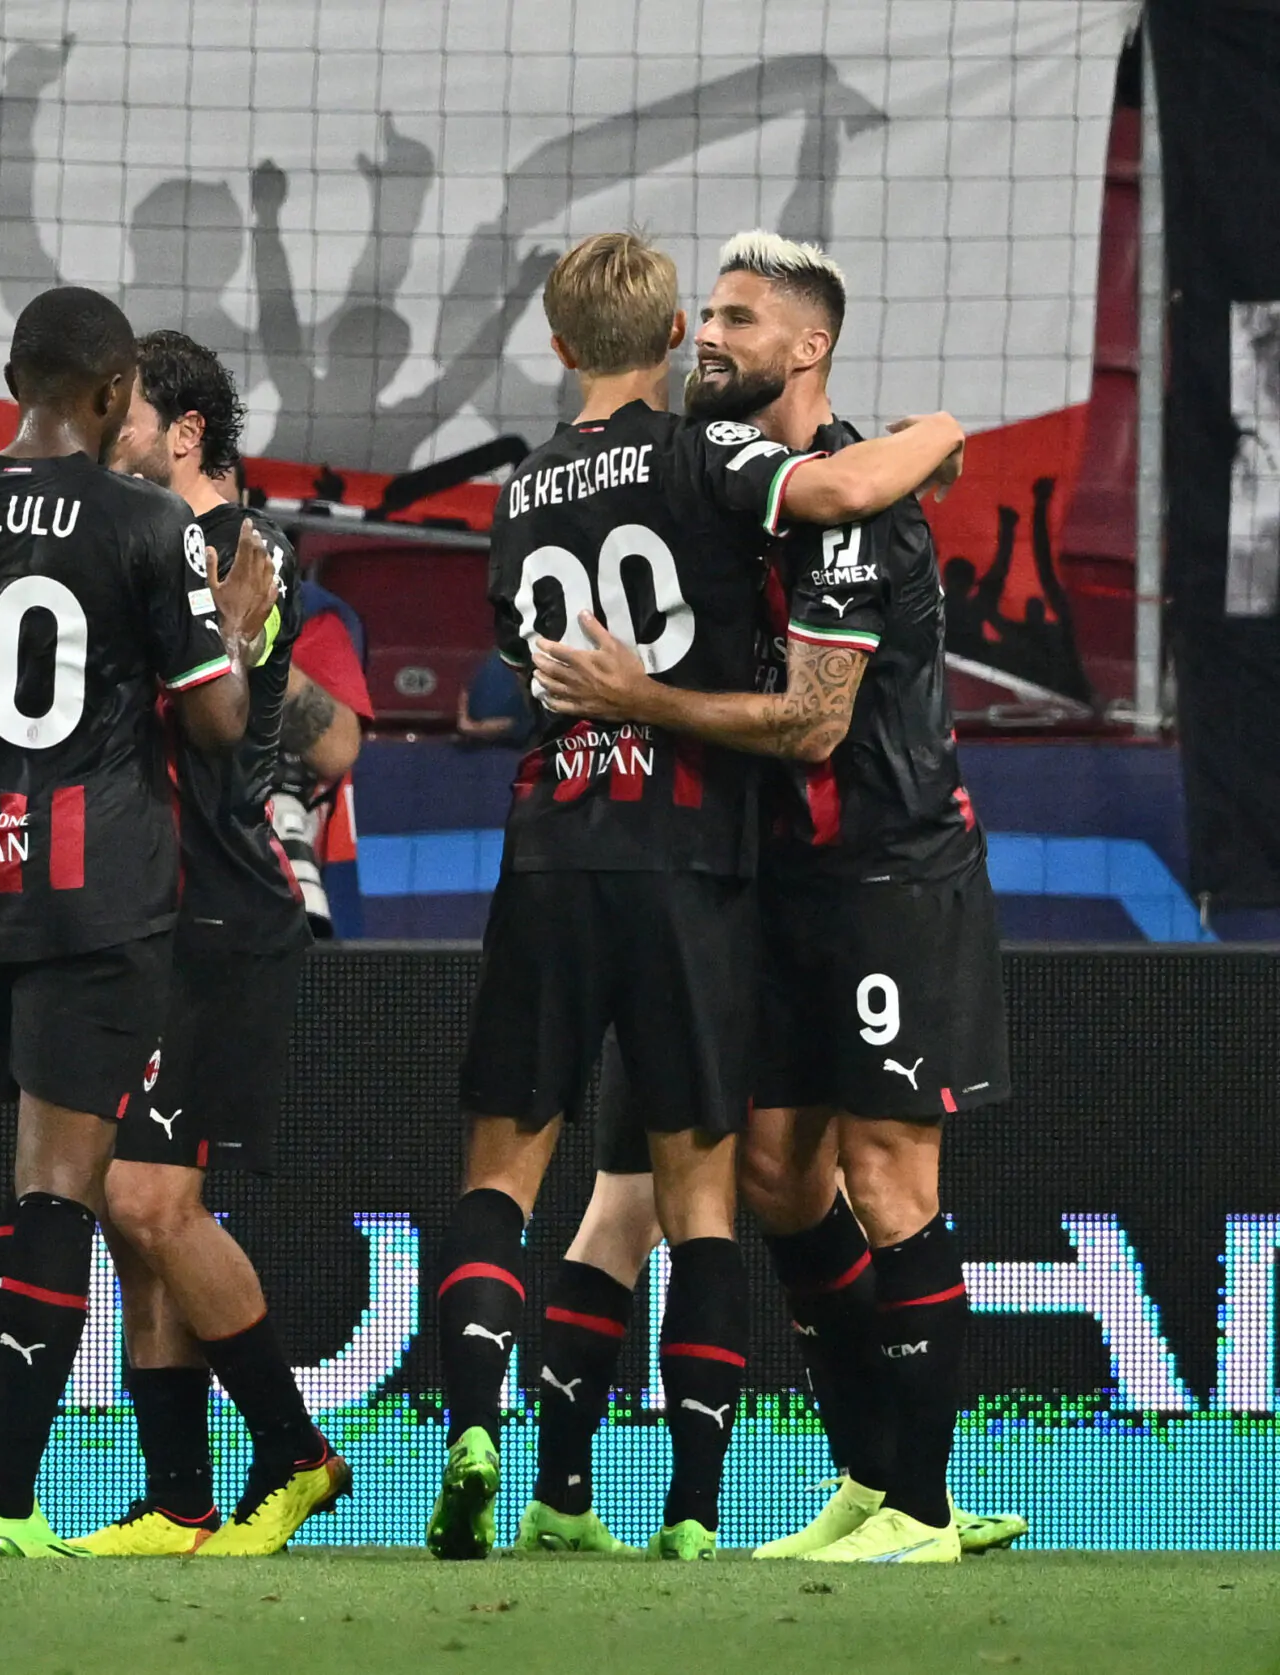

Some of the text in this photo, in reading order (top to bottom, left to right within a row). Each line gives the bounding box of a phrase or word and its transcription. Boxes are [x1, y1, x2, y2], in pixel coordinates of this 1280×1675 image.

[509, 444, 653, 519] DE KETELAERE
[811, 564, 878, 586] BitMEX
[555, 745, 654, 780] MILAN
[856, 973, 900, 1046] 9
